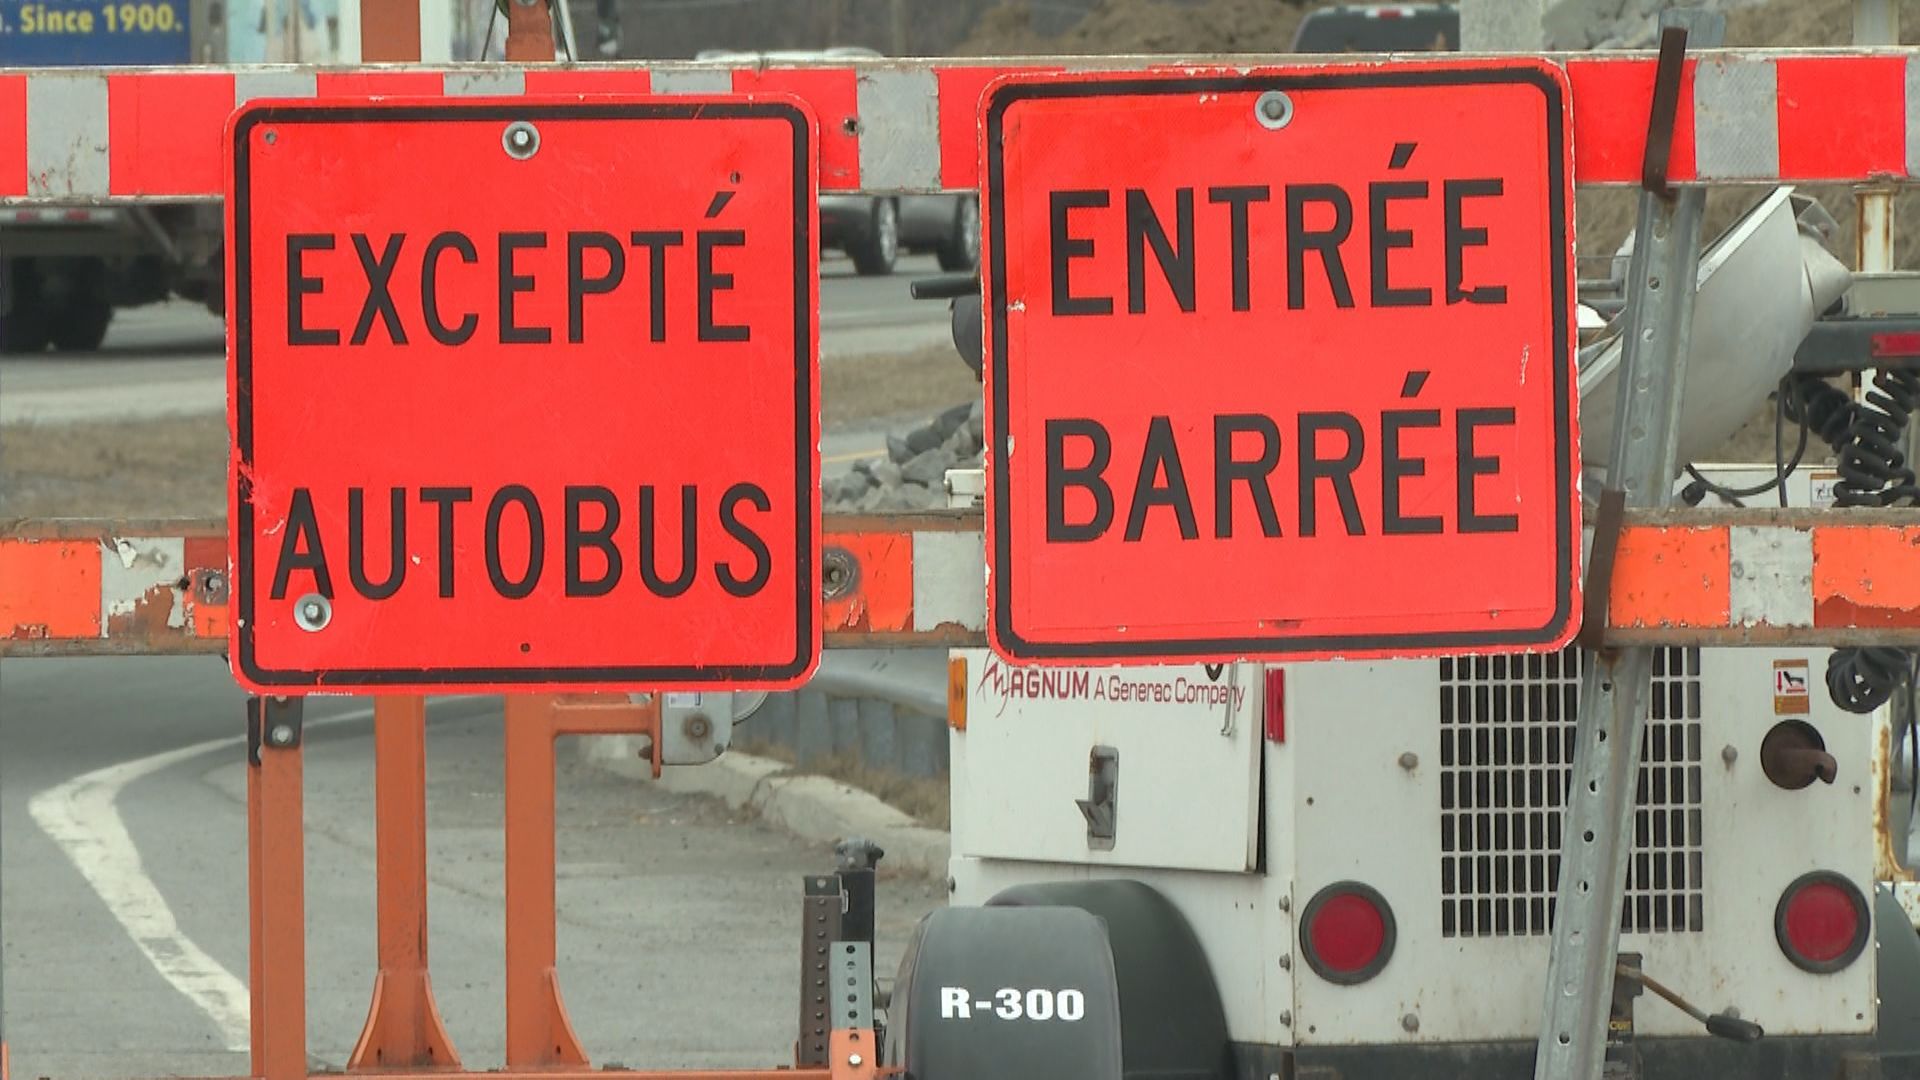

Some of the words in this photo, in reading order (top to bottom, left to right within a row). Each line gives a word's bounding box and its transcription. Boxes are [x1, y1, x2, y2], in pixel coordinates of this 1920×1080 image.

[20, 3, 94, 33] Since
[102, 3, 183, 32] 1900.
[287, 192, 750, 345] EXCEPTÉ
[1050, 143, 1507, 316] ENTRÉE
[1046, 372, 1518, 542] BARRÉE
[271, 483, 771, 600] AUTOBUS
[976, 656, 1089, 708] MAGNUM
[1094, 675, 1105, 700] A
[1109, 675, 1171, 703] Generac
[941, 987, 1085, 1021] R-300
